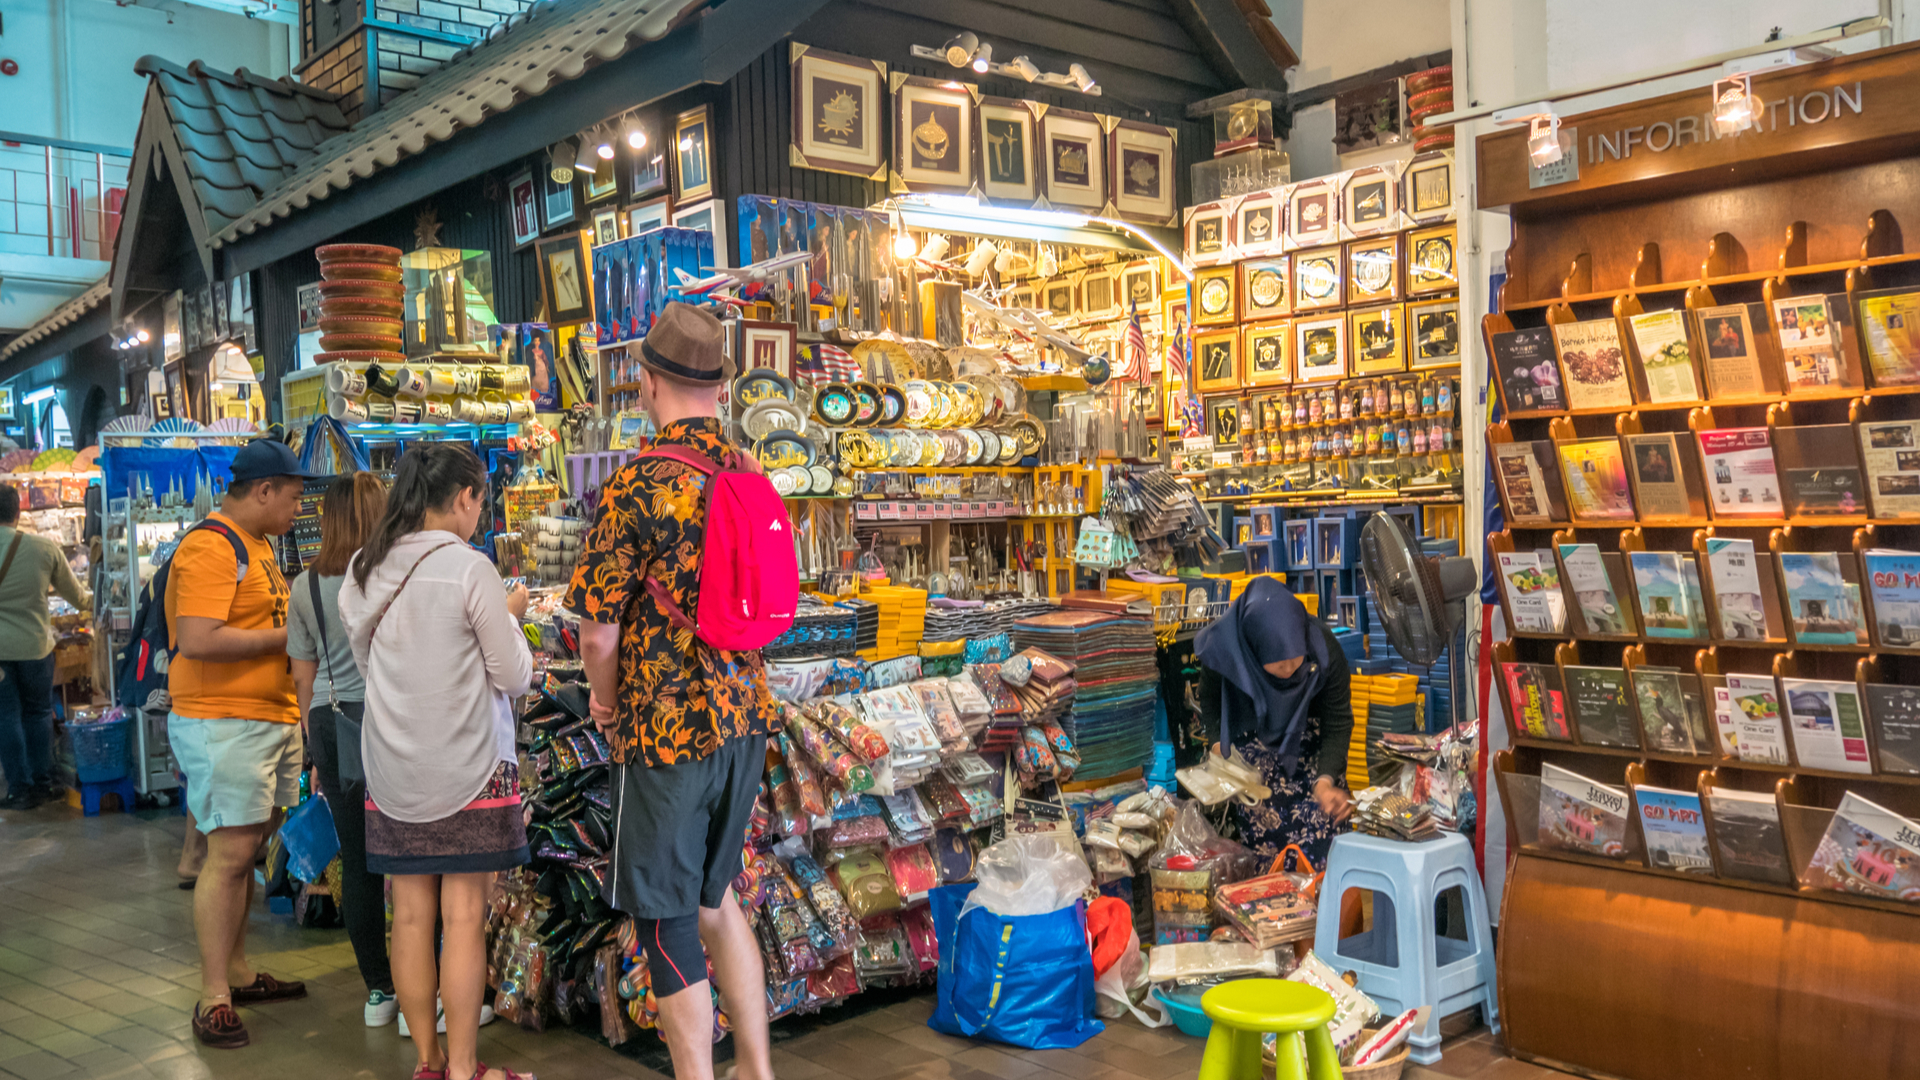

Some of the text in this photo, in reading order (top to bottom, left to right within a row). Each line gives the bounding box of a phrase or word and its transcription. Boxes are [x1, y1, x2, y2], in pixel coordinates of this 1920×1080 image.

[1561, 338, 1585, 348] Borneo
[1873, 571, 1899, 589] GO
[1743, 725, 1775, 734] One Card
[1643, 804, 1701, 825] GO MRT
